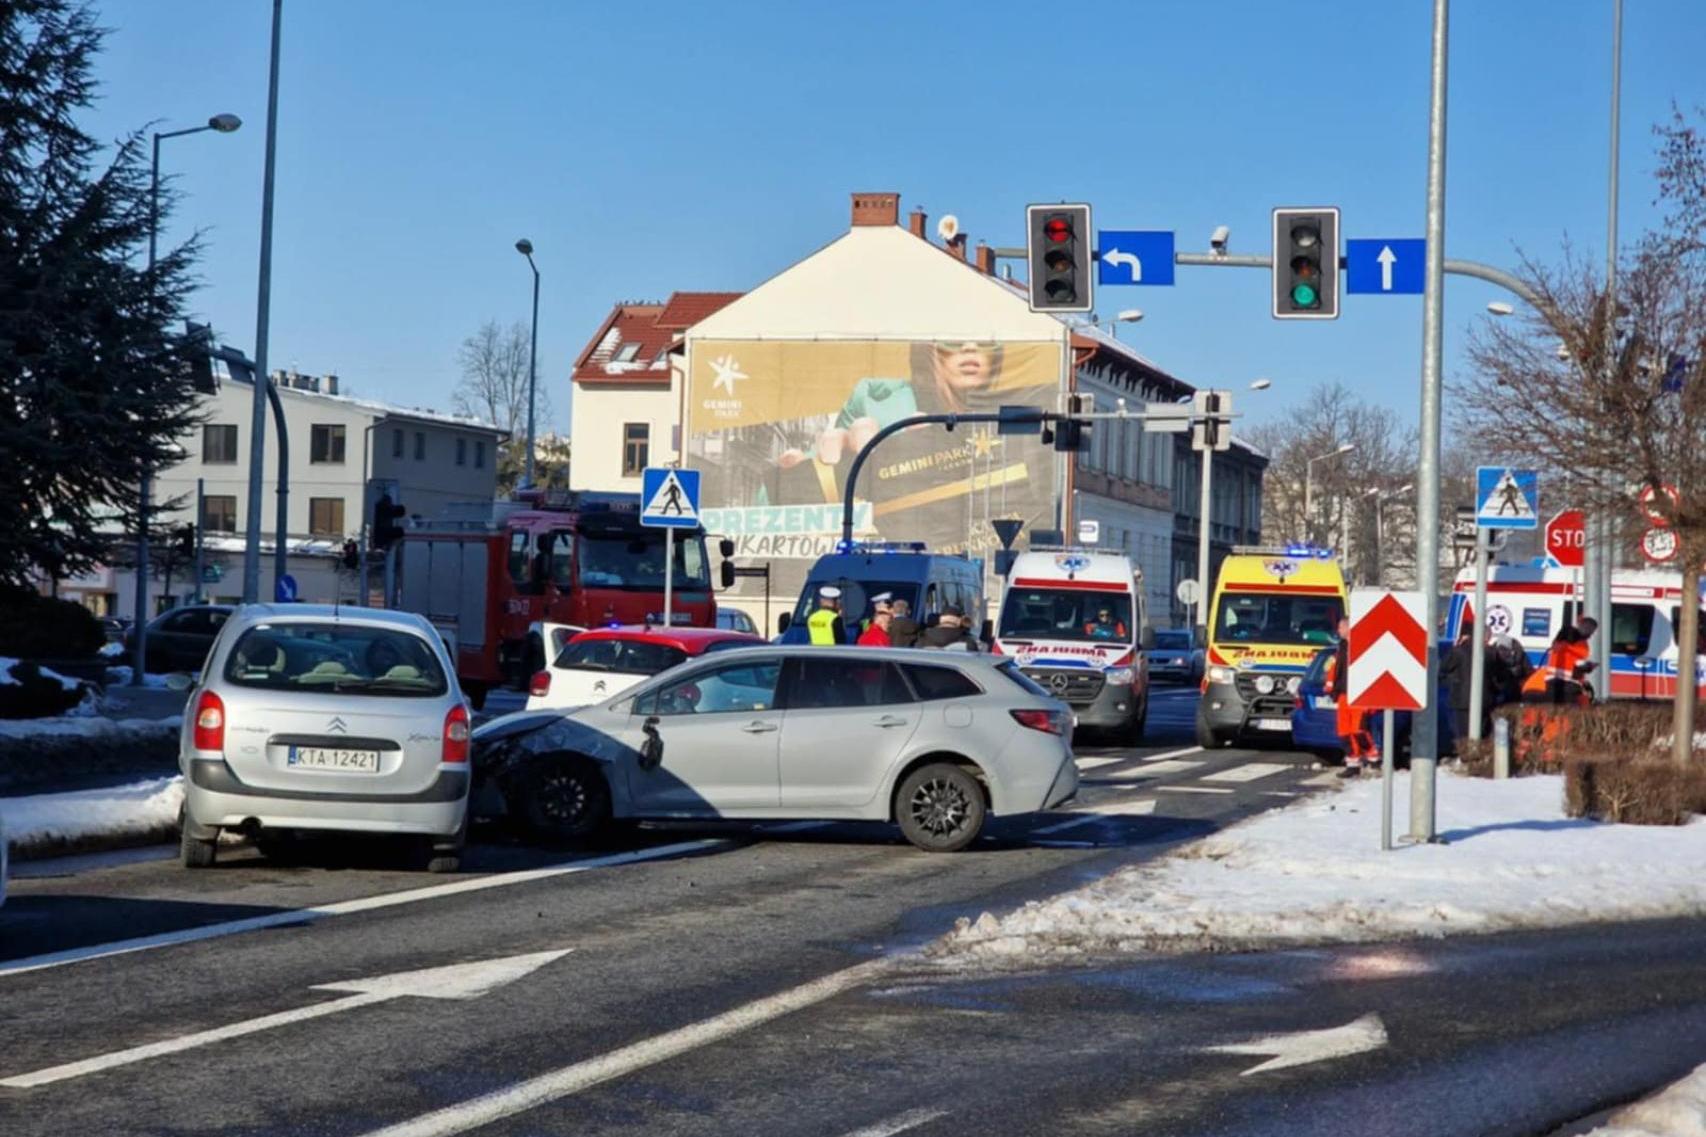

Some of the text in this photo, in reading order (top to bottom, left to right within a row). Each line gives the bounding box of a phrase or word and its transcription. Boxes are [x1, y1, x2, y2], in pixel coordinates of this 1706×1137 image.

[702, 504, 869, 533] PREZENTY
[1552, 529, 1584, 547] STO
[297, 747, 375, 768] KTA 12421
